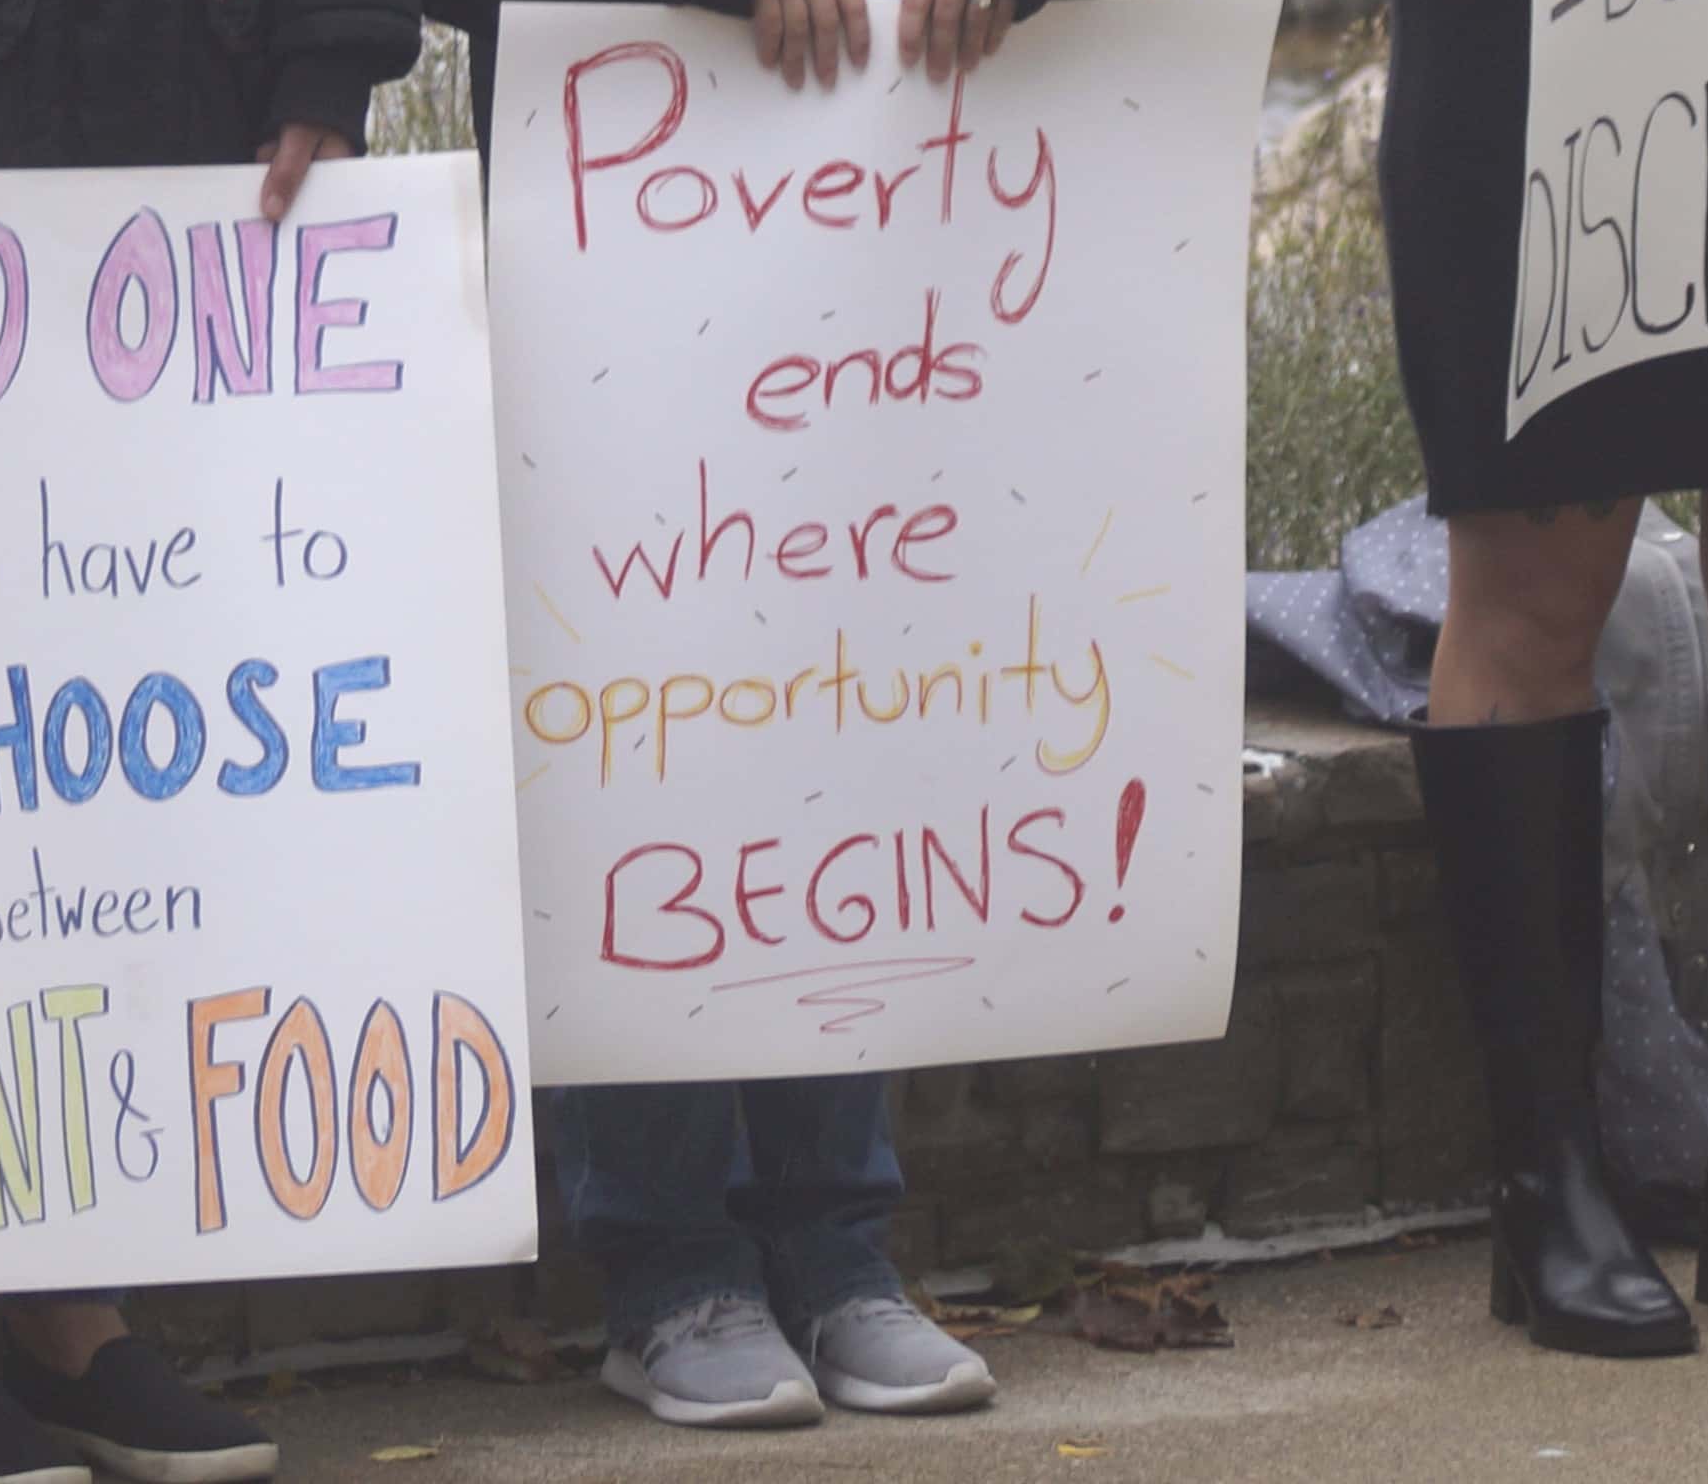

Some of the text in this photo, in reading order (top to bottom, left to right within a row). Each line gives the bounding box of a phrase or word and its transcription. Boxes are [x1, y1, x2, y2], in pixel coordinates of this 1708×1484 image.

[563, 40, 1058, 324] Poverty
[86, 204, 404, 404] ONE
[745, 287, 987, 432] ends
[40, 477, 202, 599] have
[261, 476, 347, 588] to
[592, 458, 961, 600] where
[523, 592, 1111, 788] opportunity
[599, 778, 1147, 971] BEGINS!
[109, 1048, 165, 1183] &
[187, 985, 516, 1236] FOOD
